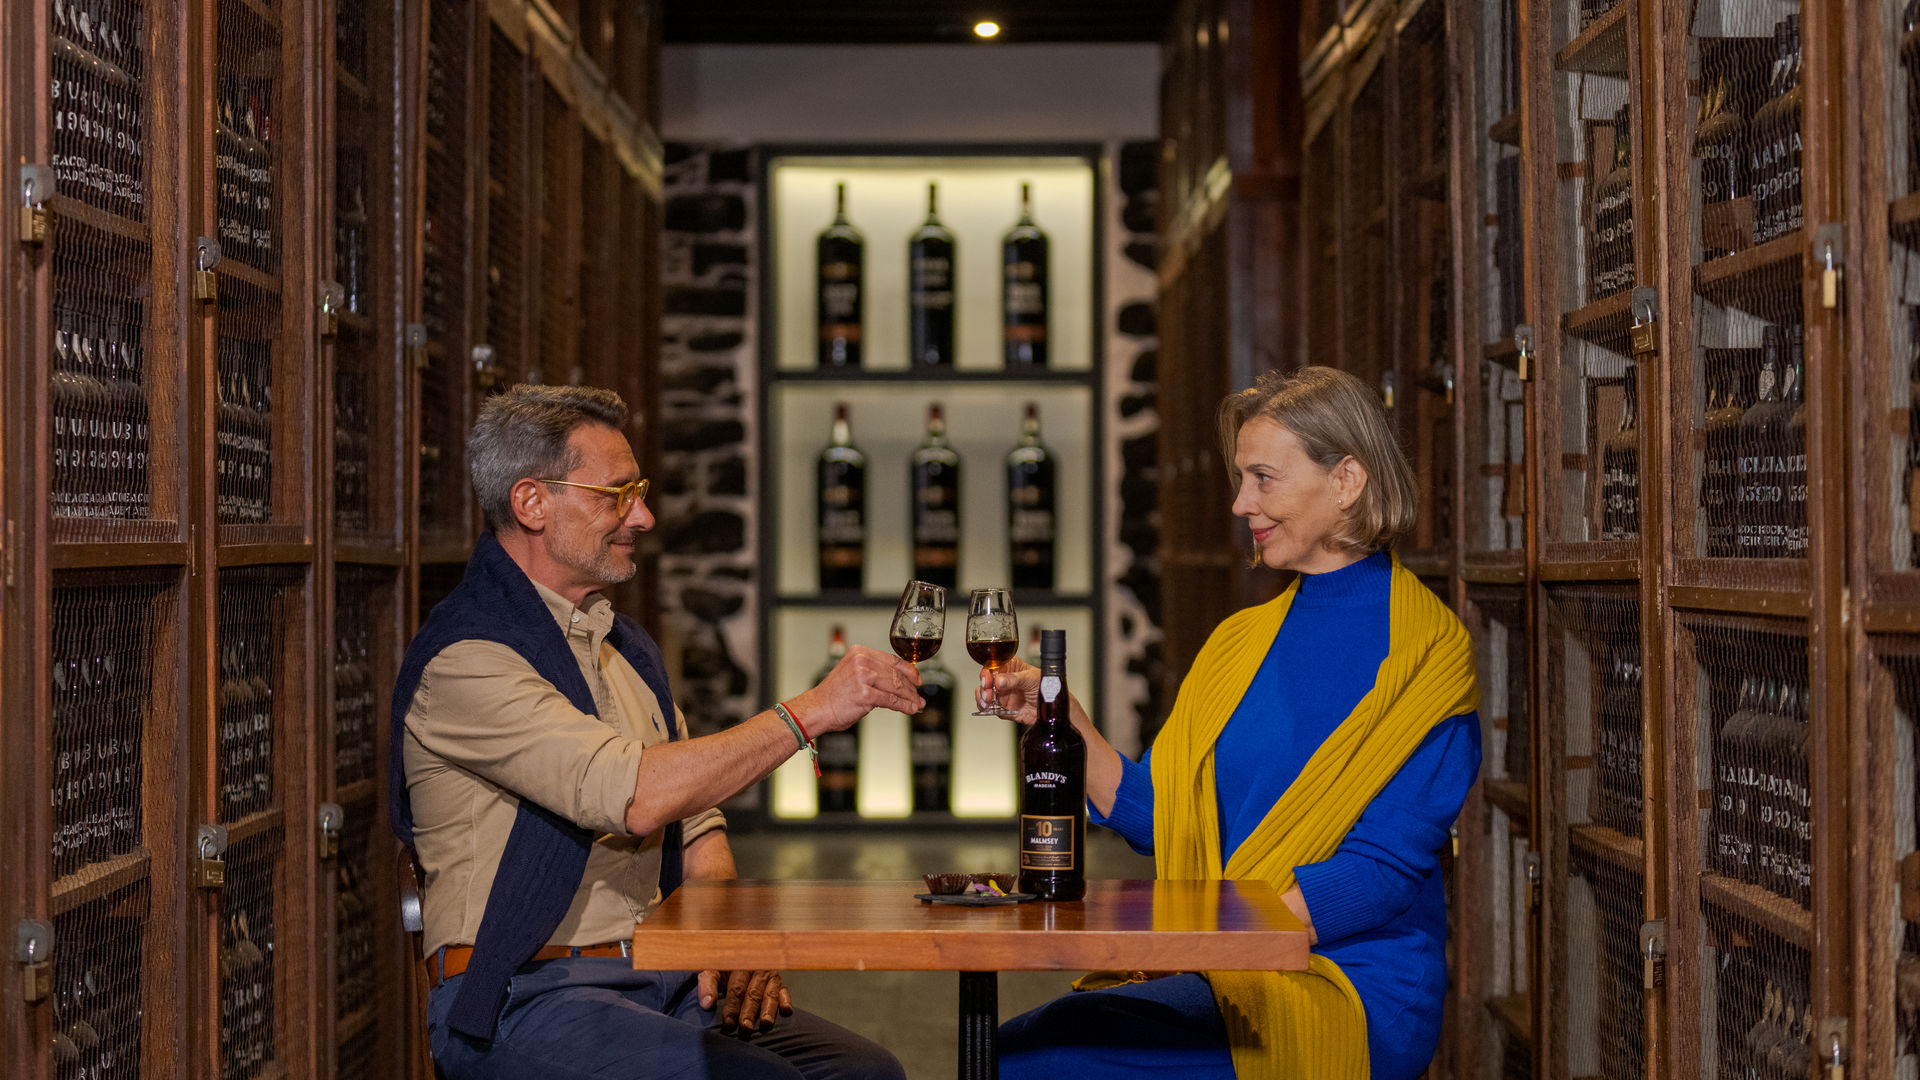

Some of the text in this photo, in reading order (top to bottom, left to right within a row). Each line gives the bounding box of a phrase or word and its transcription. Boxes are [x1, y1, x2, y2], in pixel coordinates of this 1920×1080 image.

[1025, 771, 1067, 784] BLANDY'S
[1036, 820, 1053, 837] 10
[1030, 837, 1059, 845] MALMSEY
